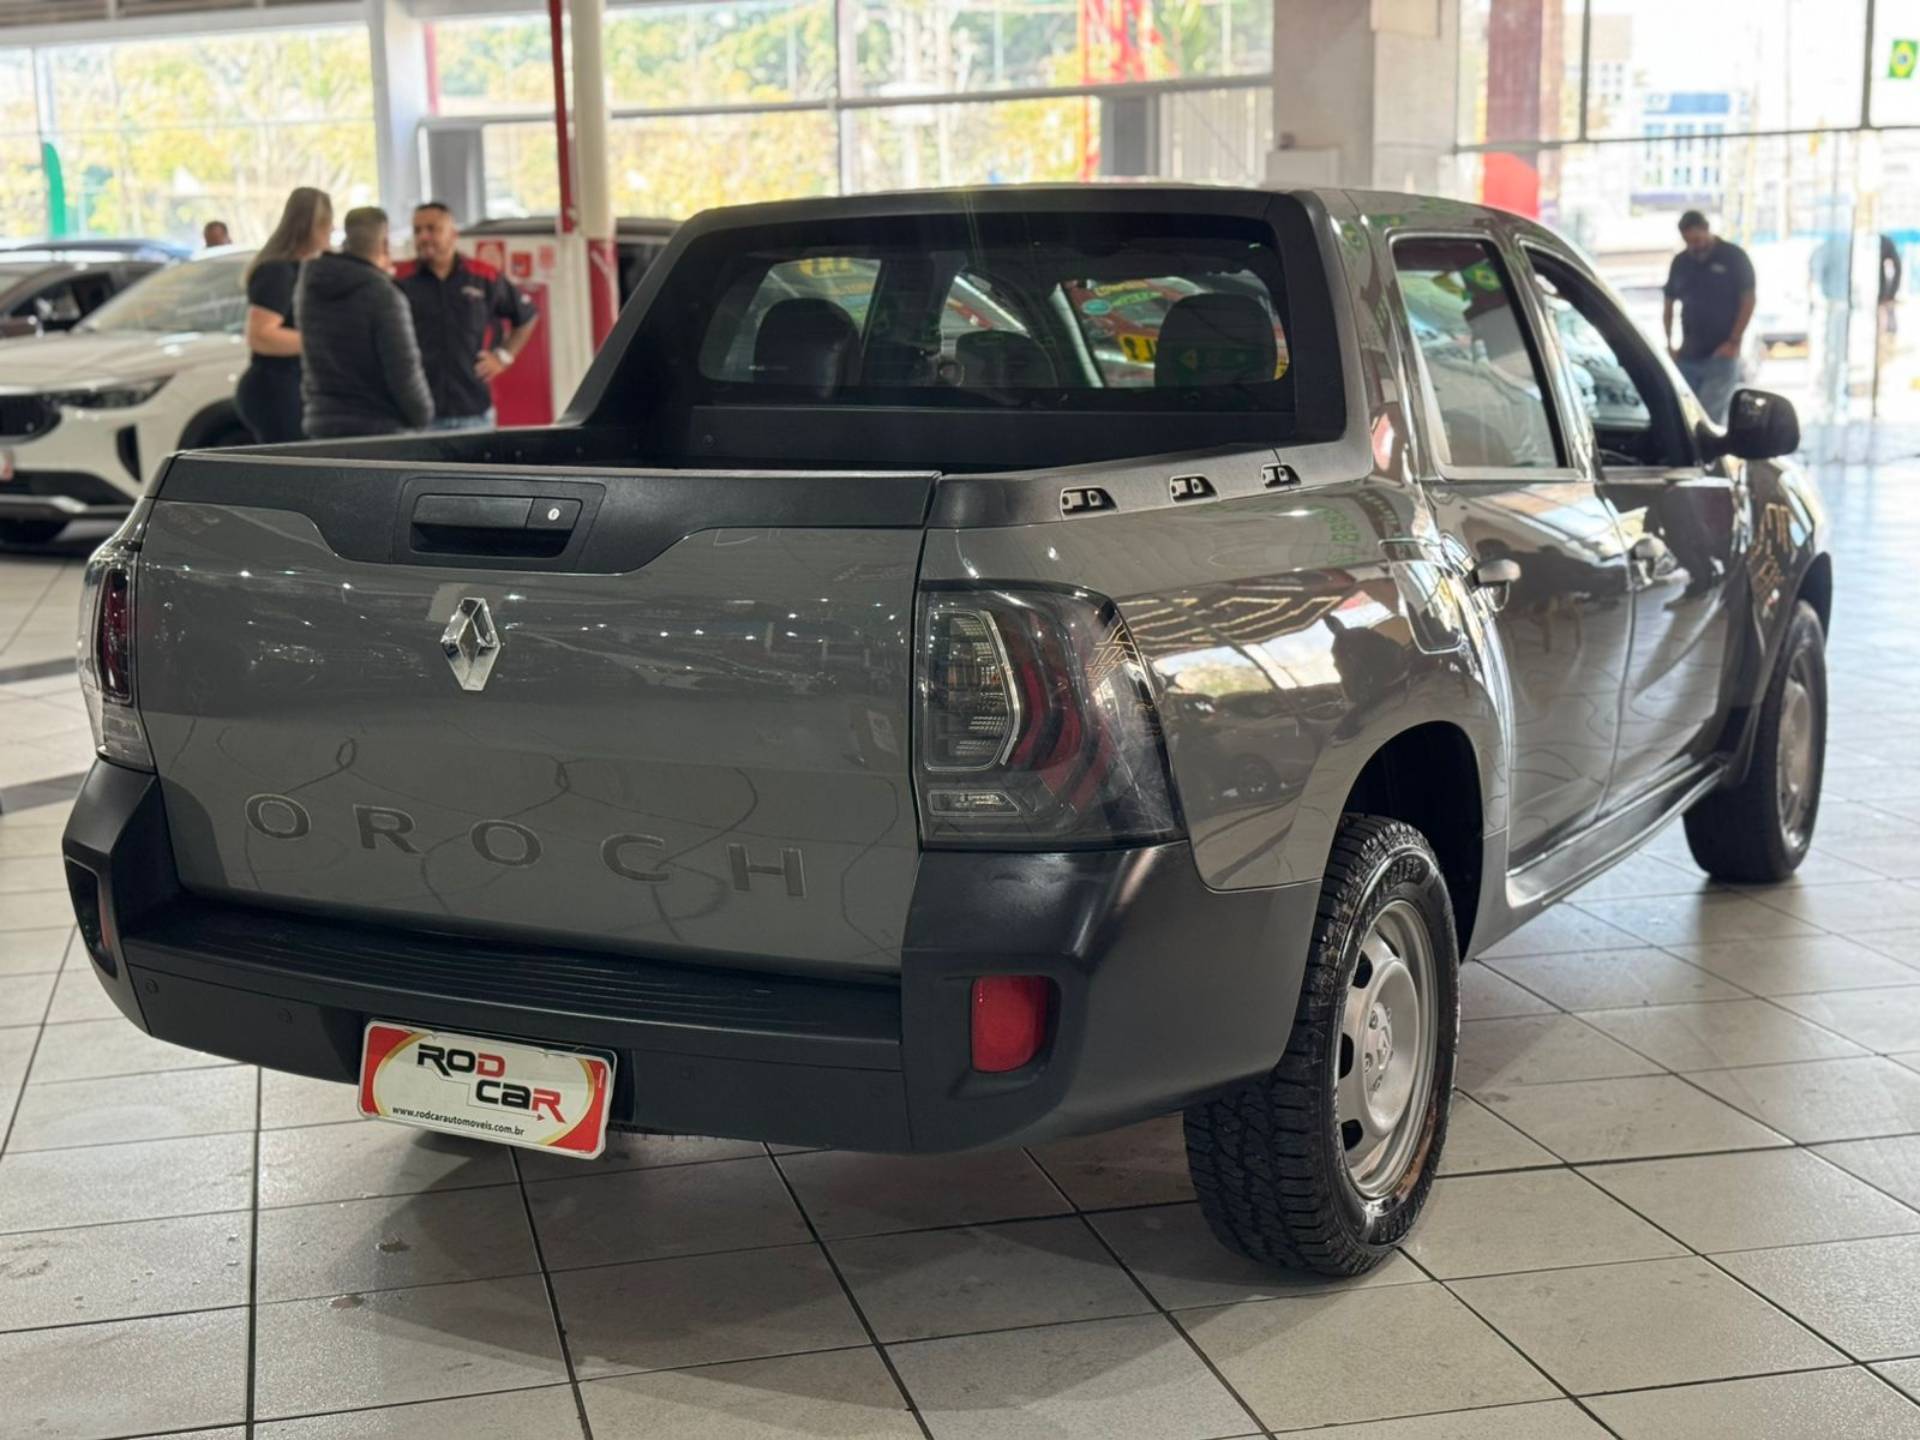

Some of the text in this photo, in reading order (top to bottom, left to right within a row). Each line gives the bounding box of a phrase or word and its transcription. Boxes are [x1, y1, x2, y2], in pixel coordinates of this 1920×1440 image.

[245, 793, 806, 898] OROCH
[417, 1043, 506, 1077] ROD
[392, 1105, 525, 1137] www.rodcarautomoveis.com.br
